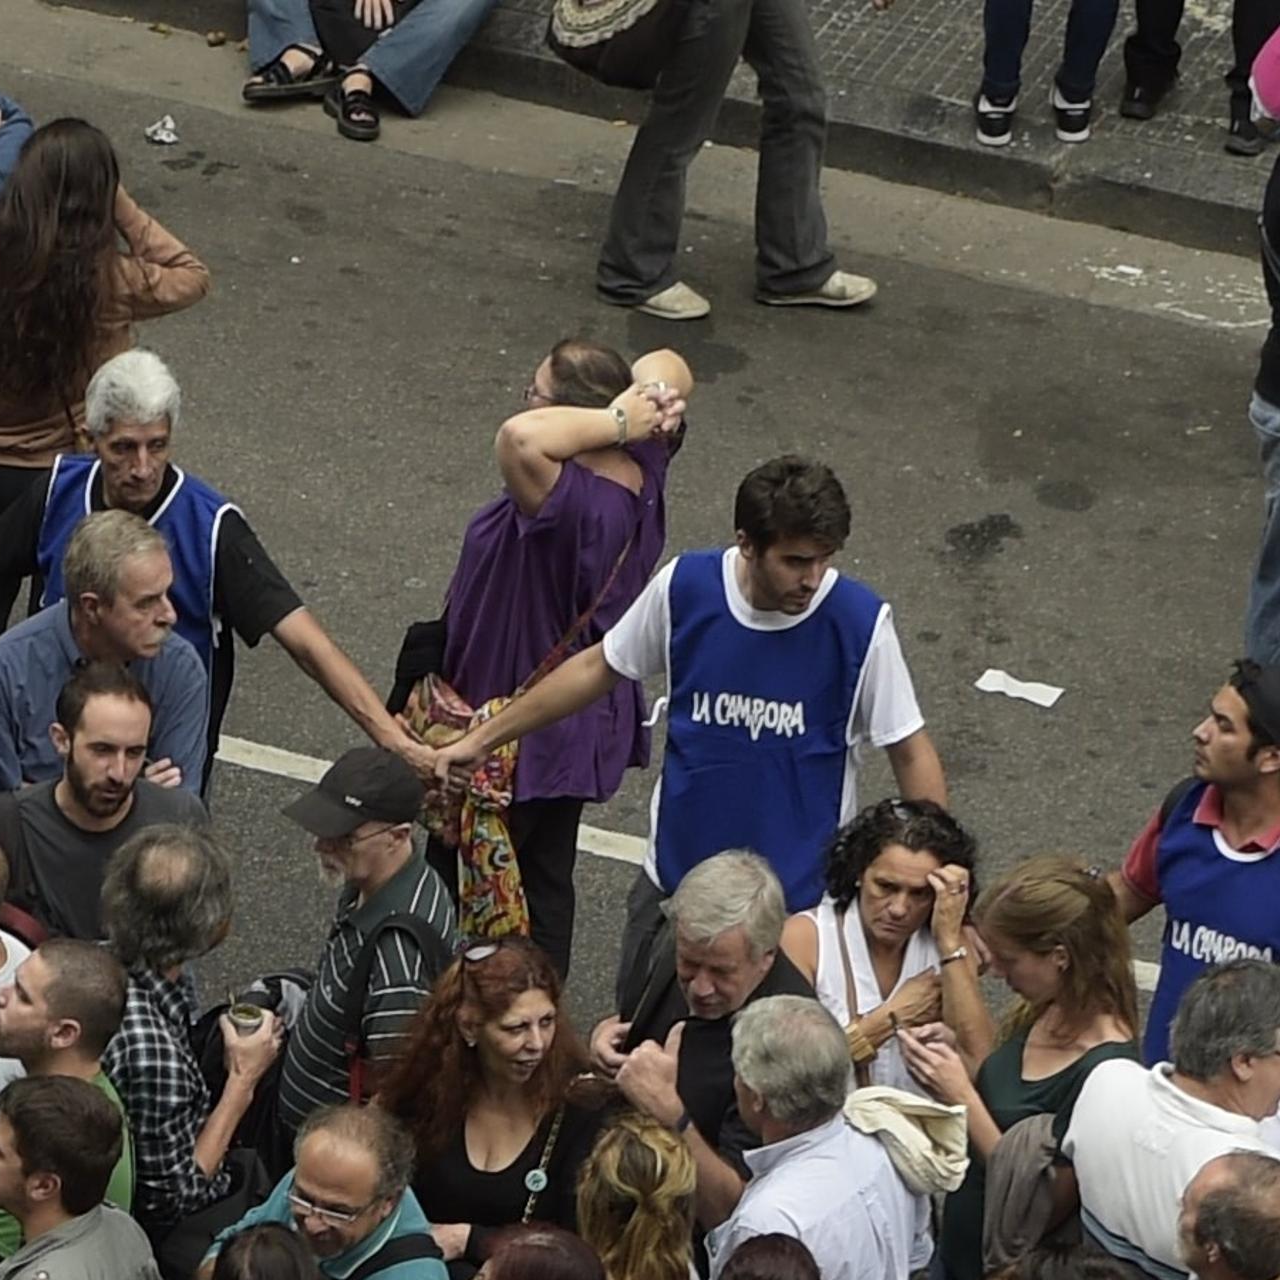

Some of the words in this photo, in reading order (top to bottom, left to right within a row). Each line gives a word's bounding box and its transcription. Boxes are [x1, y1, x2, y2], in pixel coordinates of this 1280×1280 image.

[692, 692, 711, 725] LA
[714, 692, 805, 741] CAMPORA
[1171, 920, 1190, 955] LA
